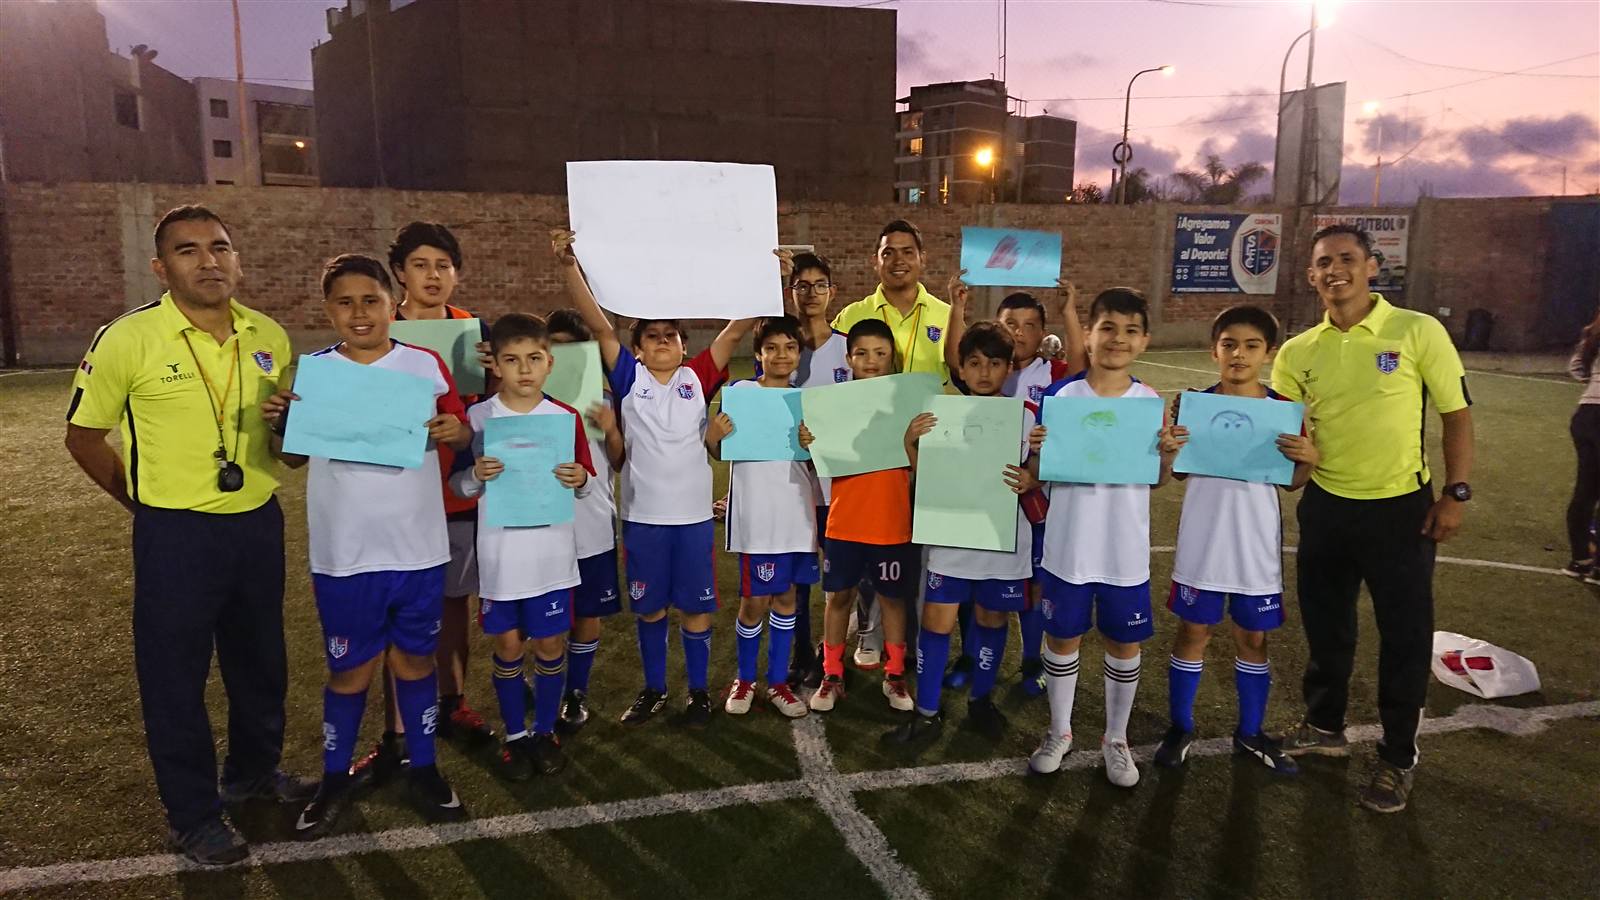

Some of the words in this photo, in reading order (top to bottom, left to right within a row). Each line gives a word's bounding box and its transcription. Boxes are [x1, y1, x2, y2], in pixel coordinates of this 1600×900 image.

[1194, 232, 1216, 245] Valor
[1180, 248, 1190, 260] al
[1191, 247, 1230, 262] Deporte!
[160, 372, 196, 384] TORELLI
[878, 561, 901, 581] 10
